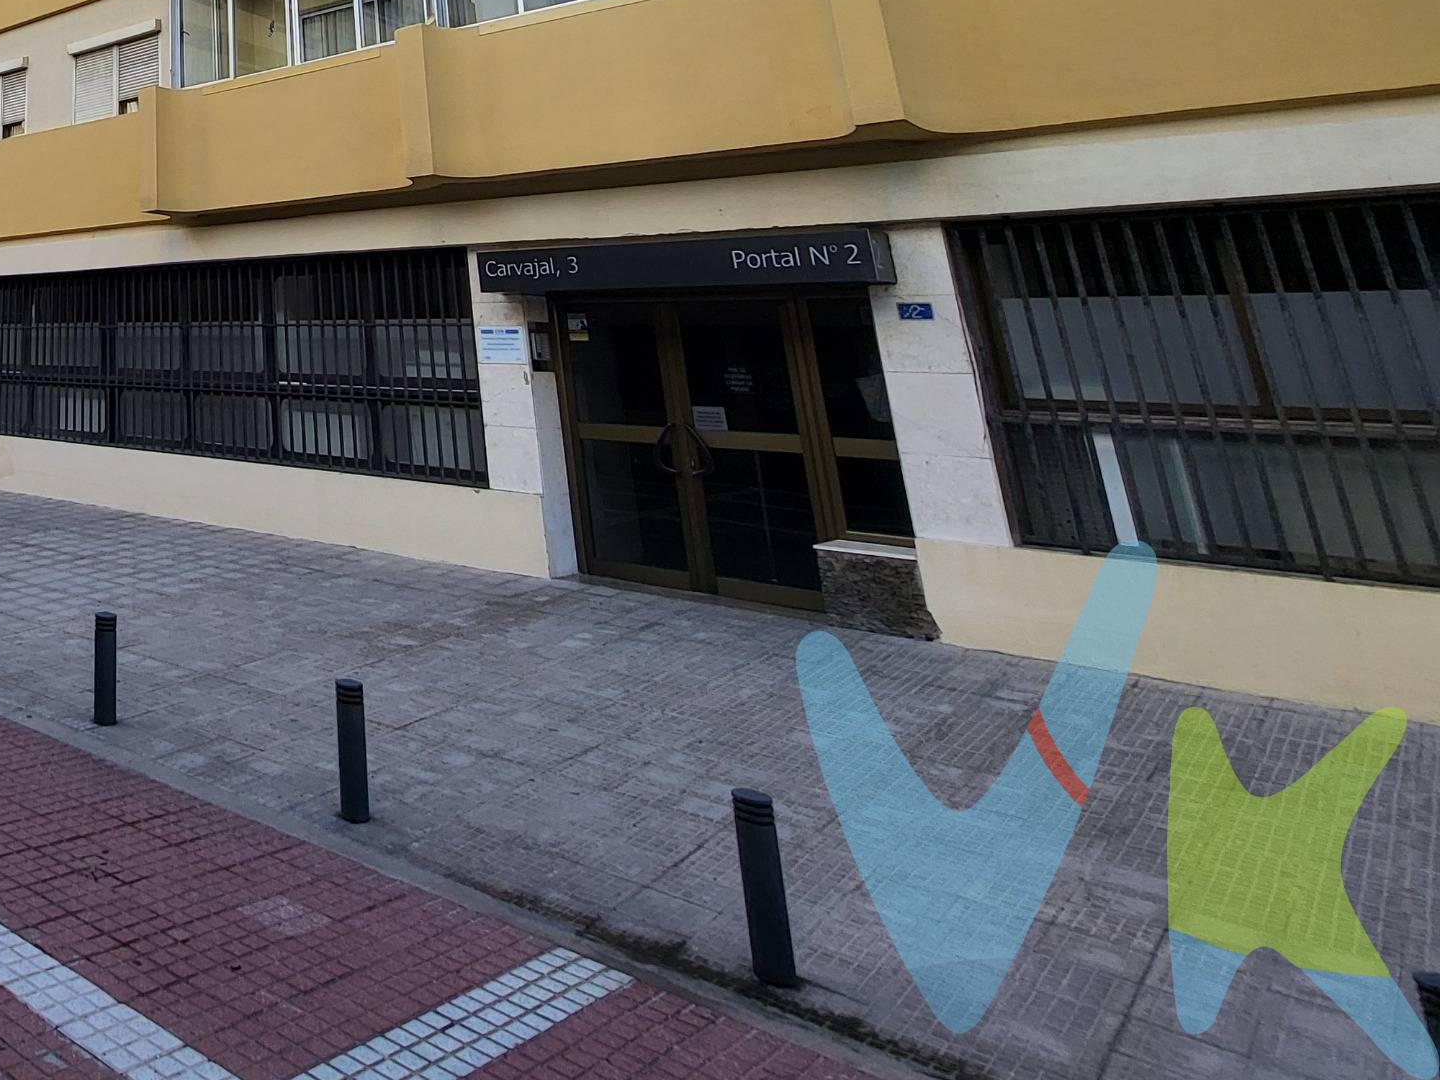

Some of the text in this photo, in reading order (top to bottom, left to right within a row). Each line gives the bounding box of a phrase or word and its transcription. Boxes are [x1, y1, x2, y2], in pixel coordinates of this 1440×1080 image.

[485, 256, 579, 279] Carvajal, 3
[731, 246, 801, 269] Portal
[843, 243, 862, 265] 2
